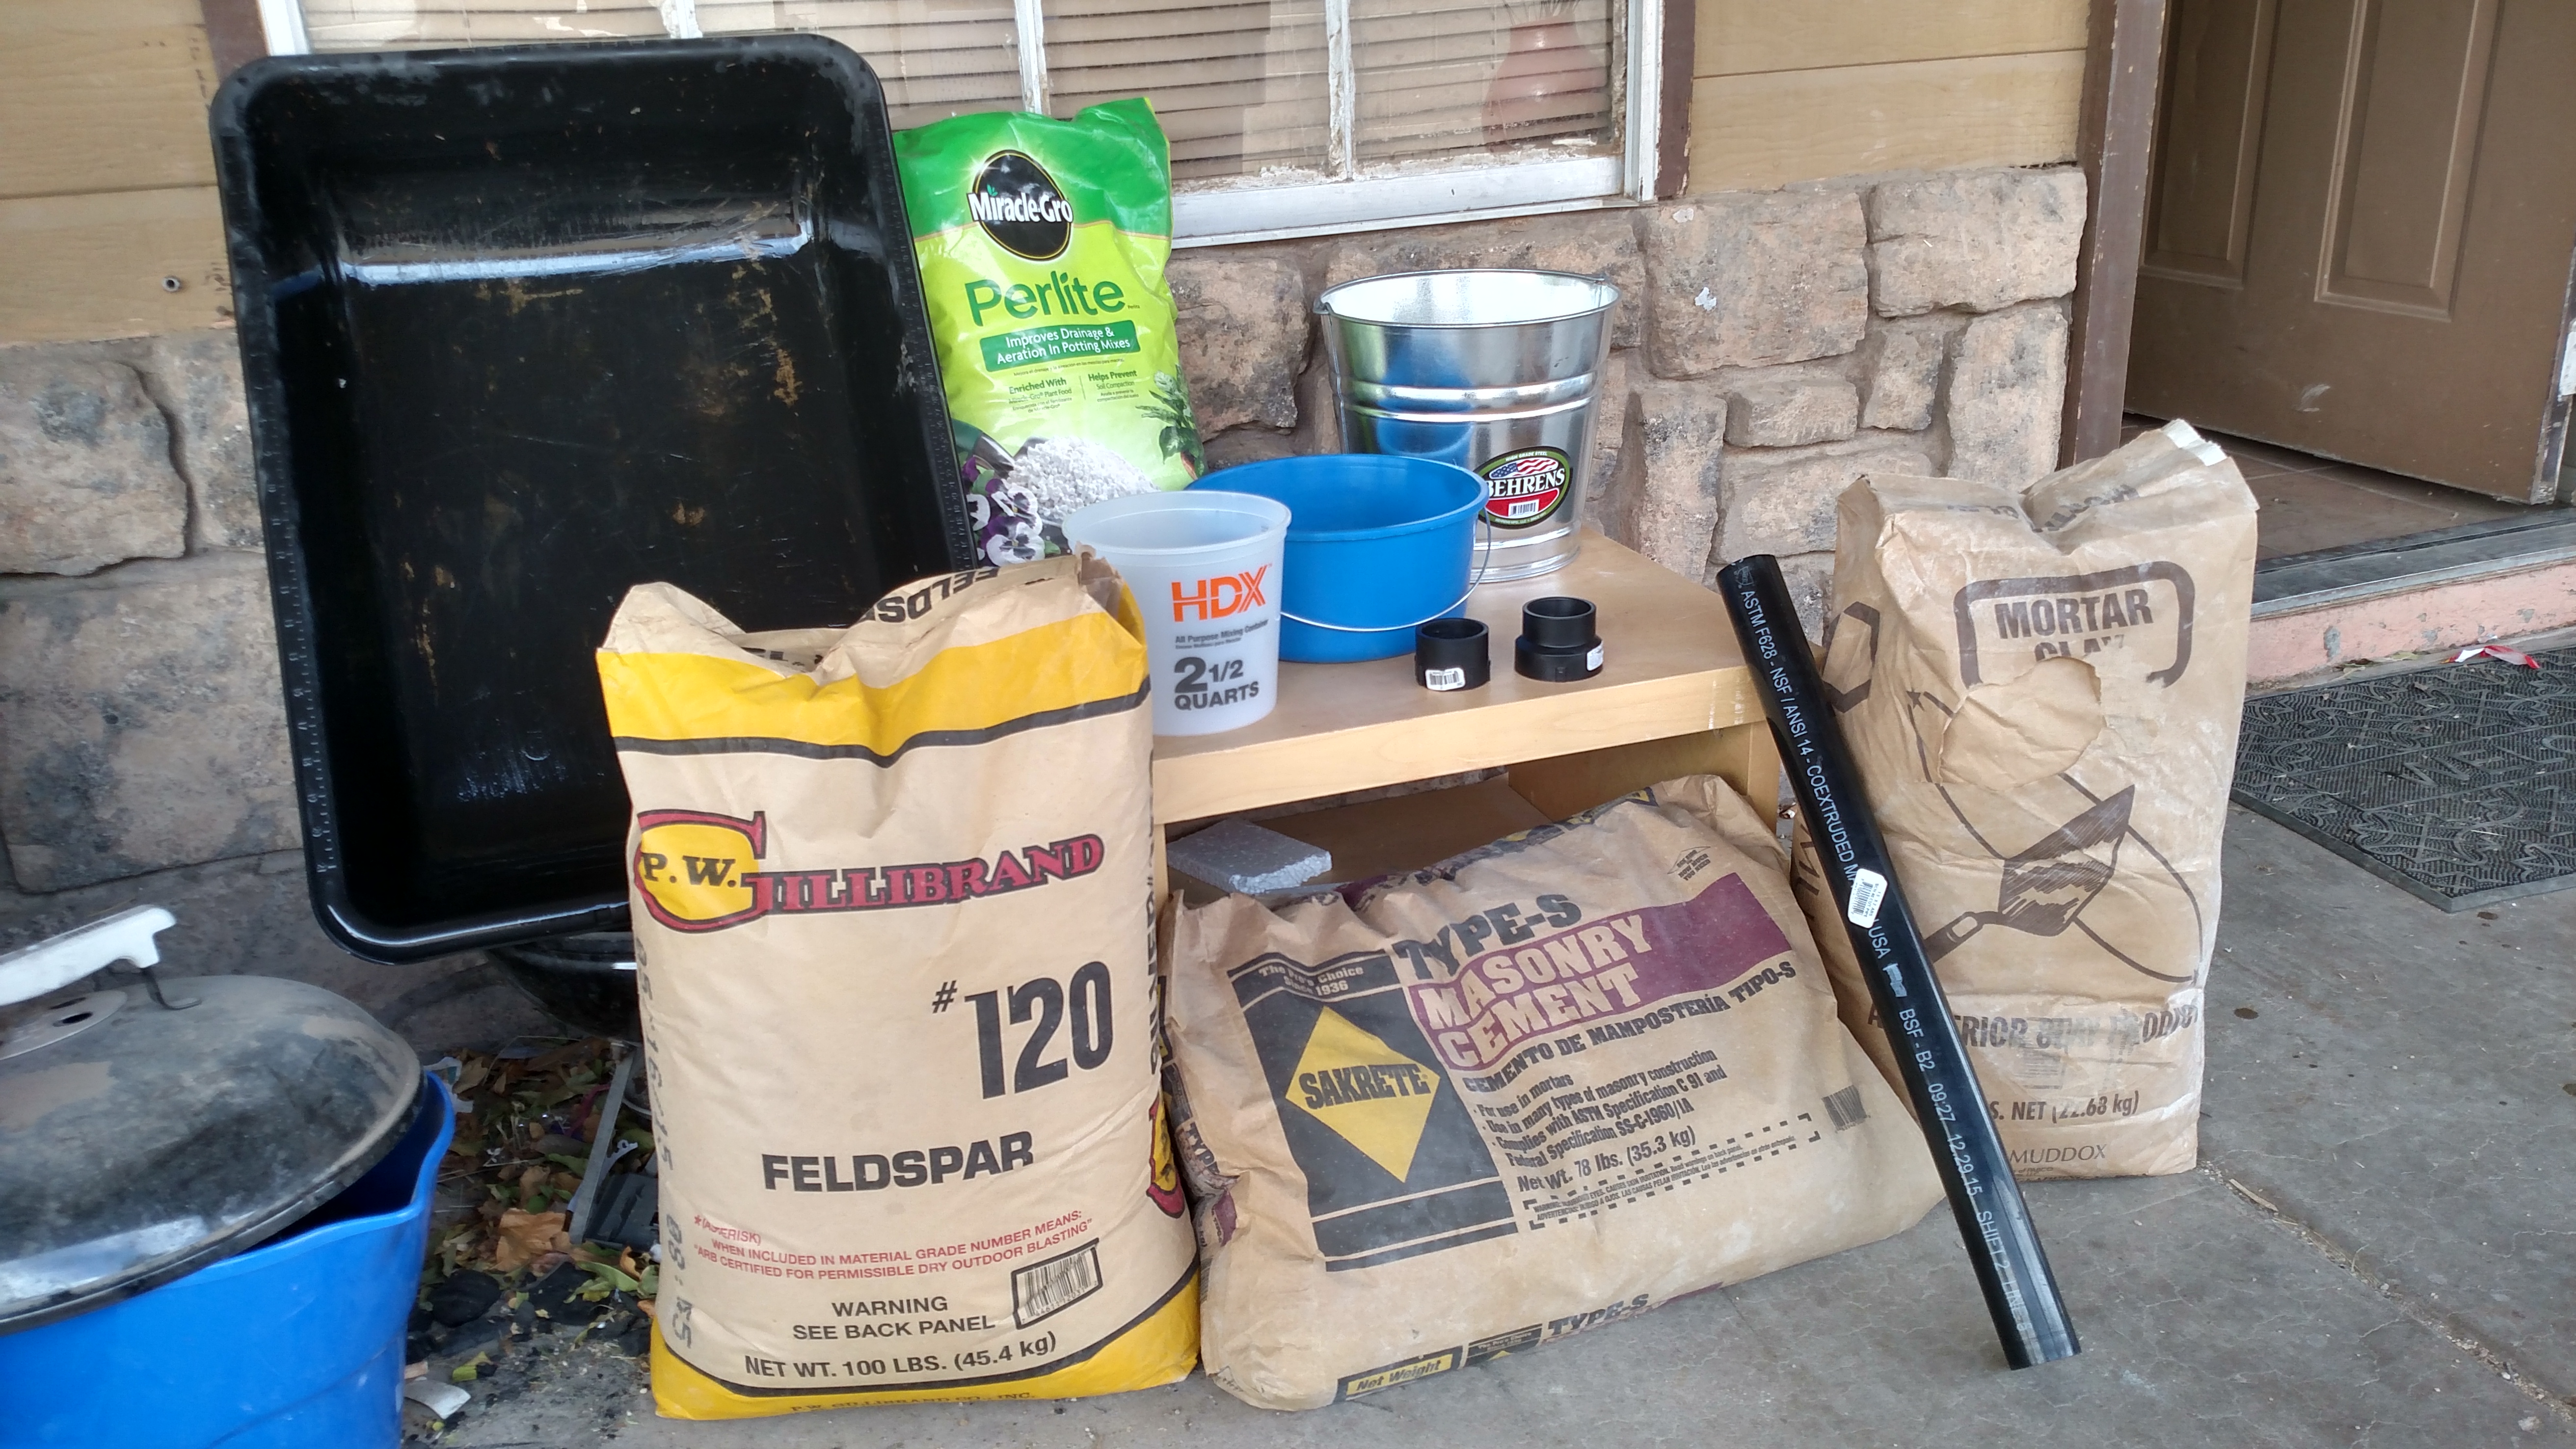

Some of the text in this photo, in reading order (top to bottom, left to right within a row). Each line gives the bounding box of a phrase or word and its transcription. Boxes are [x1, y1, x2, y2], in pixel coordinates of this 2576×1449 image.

[965, 270, 1126, 326] Perlite
[997, 339, 1130, 365] Aeration In Potting Mixes
[1006, 327, 1114, 349] Improves Drainage &
[1009, 377, 1067, 394] Enriched With
[1045, 390, 1058, 398] Plant
[1088, 370, 1137, 382] Helps Prevent
[1106, 380, 1134, 389] Compaction
[1171, 565, 1268, 622] HDX
[1994, 588, 2153, 639] MORTAR
[1188, 634, 1218, 643] Purpose
[1221, 629, 1243, 638] Mixing
[1174, 657, 1244, 694] 2 1/2
[1175, 681, 1260, 710] QUARTS
[1741, 590, 1767, 628] ASTM
[1755, 627, 1778, 660] F628
[1770, 667, 1793, 695] NSF
[1783, 705, 1808, 738] ANSI
[1797, 739, 1815, 756] 14
[1806, 765, 1855, 863] COEXTRUDED
[1868, 926, 1891, 960] USA
[1683, 870, 1695, 881] YOU
[1695, 859, 1711, 872] NEED
[1691, 853, 1708, 867] MUCH
[1391, 894, 1582, 980] TYPE-S
[1259, 965, 1286, 977] The
[1317, 966, 1364, 984] Choice
[1315, 980, 1349, 996] 1936
[1419, 914, 1652, 1030] MASONRY
[1439, 962, 1639, 1070] CEMENT
[1462, 961, 1797, 1093] CEMENTO DE MAMPOSTERÍA TIPO-S
[1299, 1064, 1431, 1110] SAKRETE
[1486, 1049, 1718, 1134] Use in many types of masonry construction
[1497, 1102, 1519, 1118] use
[1517, 1095, 1531, 1108] in
[1529, 1074, 1574, 1100] mortars
[2012, 1101, 2047, 1120] NET
[2113, 1090, 2139, 1119] kg)
[1496, 1064, 1728, 1154] Complies with ASTM Specification C 91 and
[1505, 1151, 1550, 1168] Federal
[1546, 1125, 1618, 1159] Specification
[1899, 1008, 1924, 1038] BSF
[1915, 1050, 1935, 1073] B2
[1928, 1083, 1957, 1122] 09:27
[1977, 1210, 2007, 1255] SHIFT
[1994, 1260, 2011, 1271] 2
[2010, 1143, 2107, 1164] MUDDOX
[762, 1131, 1034, 1192] FELDSPAR
[1517, 1125, 1696, 1192] Net Wt. 78 lbs. (35.3 kg)
[1590, 1188, 1606, 1199] EYES.
[1606, 1181, 1627, 1193] CAUSES
[1628, 1179, 1639, 1187] SKIN
[1670, 1163, 1685, 1172] Read
[1621, 1189, 1632, 1198] LAS
[1632, 1182, 1653, 1195] CAUSAS
[712, 1210, 1082, 1265] WHEN INCLUDED IN MATERIAL GRADE NUMBER MEANS:
[720, 1257, 782, 1278] CERTIFIED
[786, 1269, 814, 1279] FOR
[819, 1265, 914, 1280] PERMISSIBLE
[918, 1261, 948, 1275] DRY
[952, 1246, 1023, 1270] OUTDOOR
[832, 1296, 948, 1317] WARNING
[1548, 1293, 1650, 1336] TYPE-S
[793, 1315, 995, 1340] SEE BACK PANEL
[745, 1331, 1056, 1377] NET WT. 100 LBS. (45.4 kg)
[1356, 1359, 1443, 1392] Net Weight
